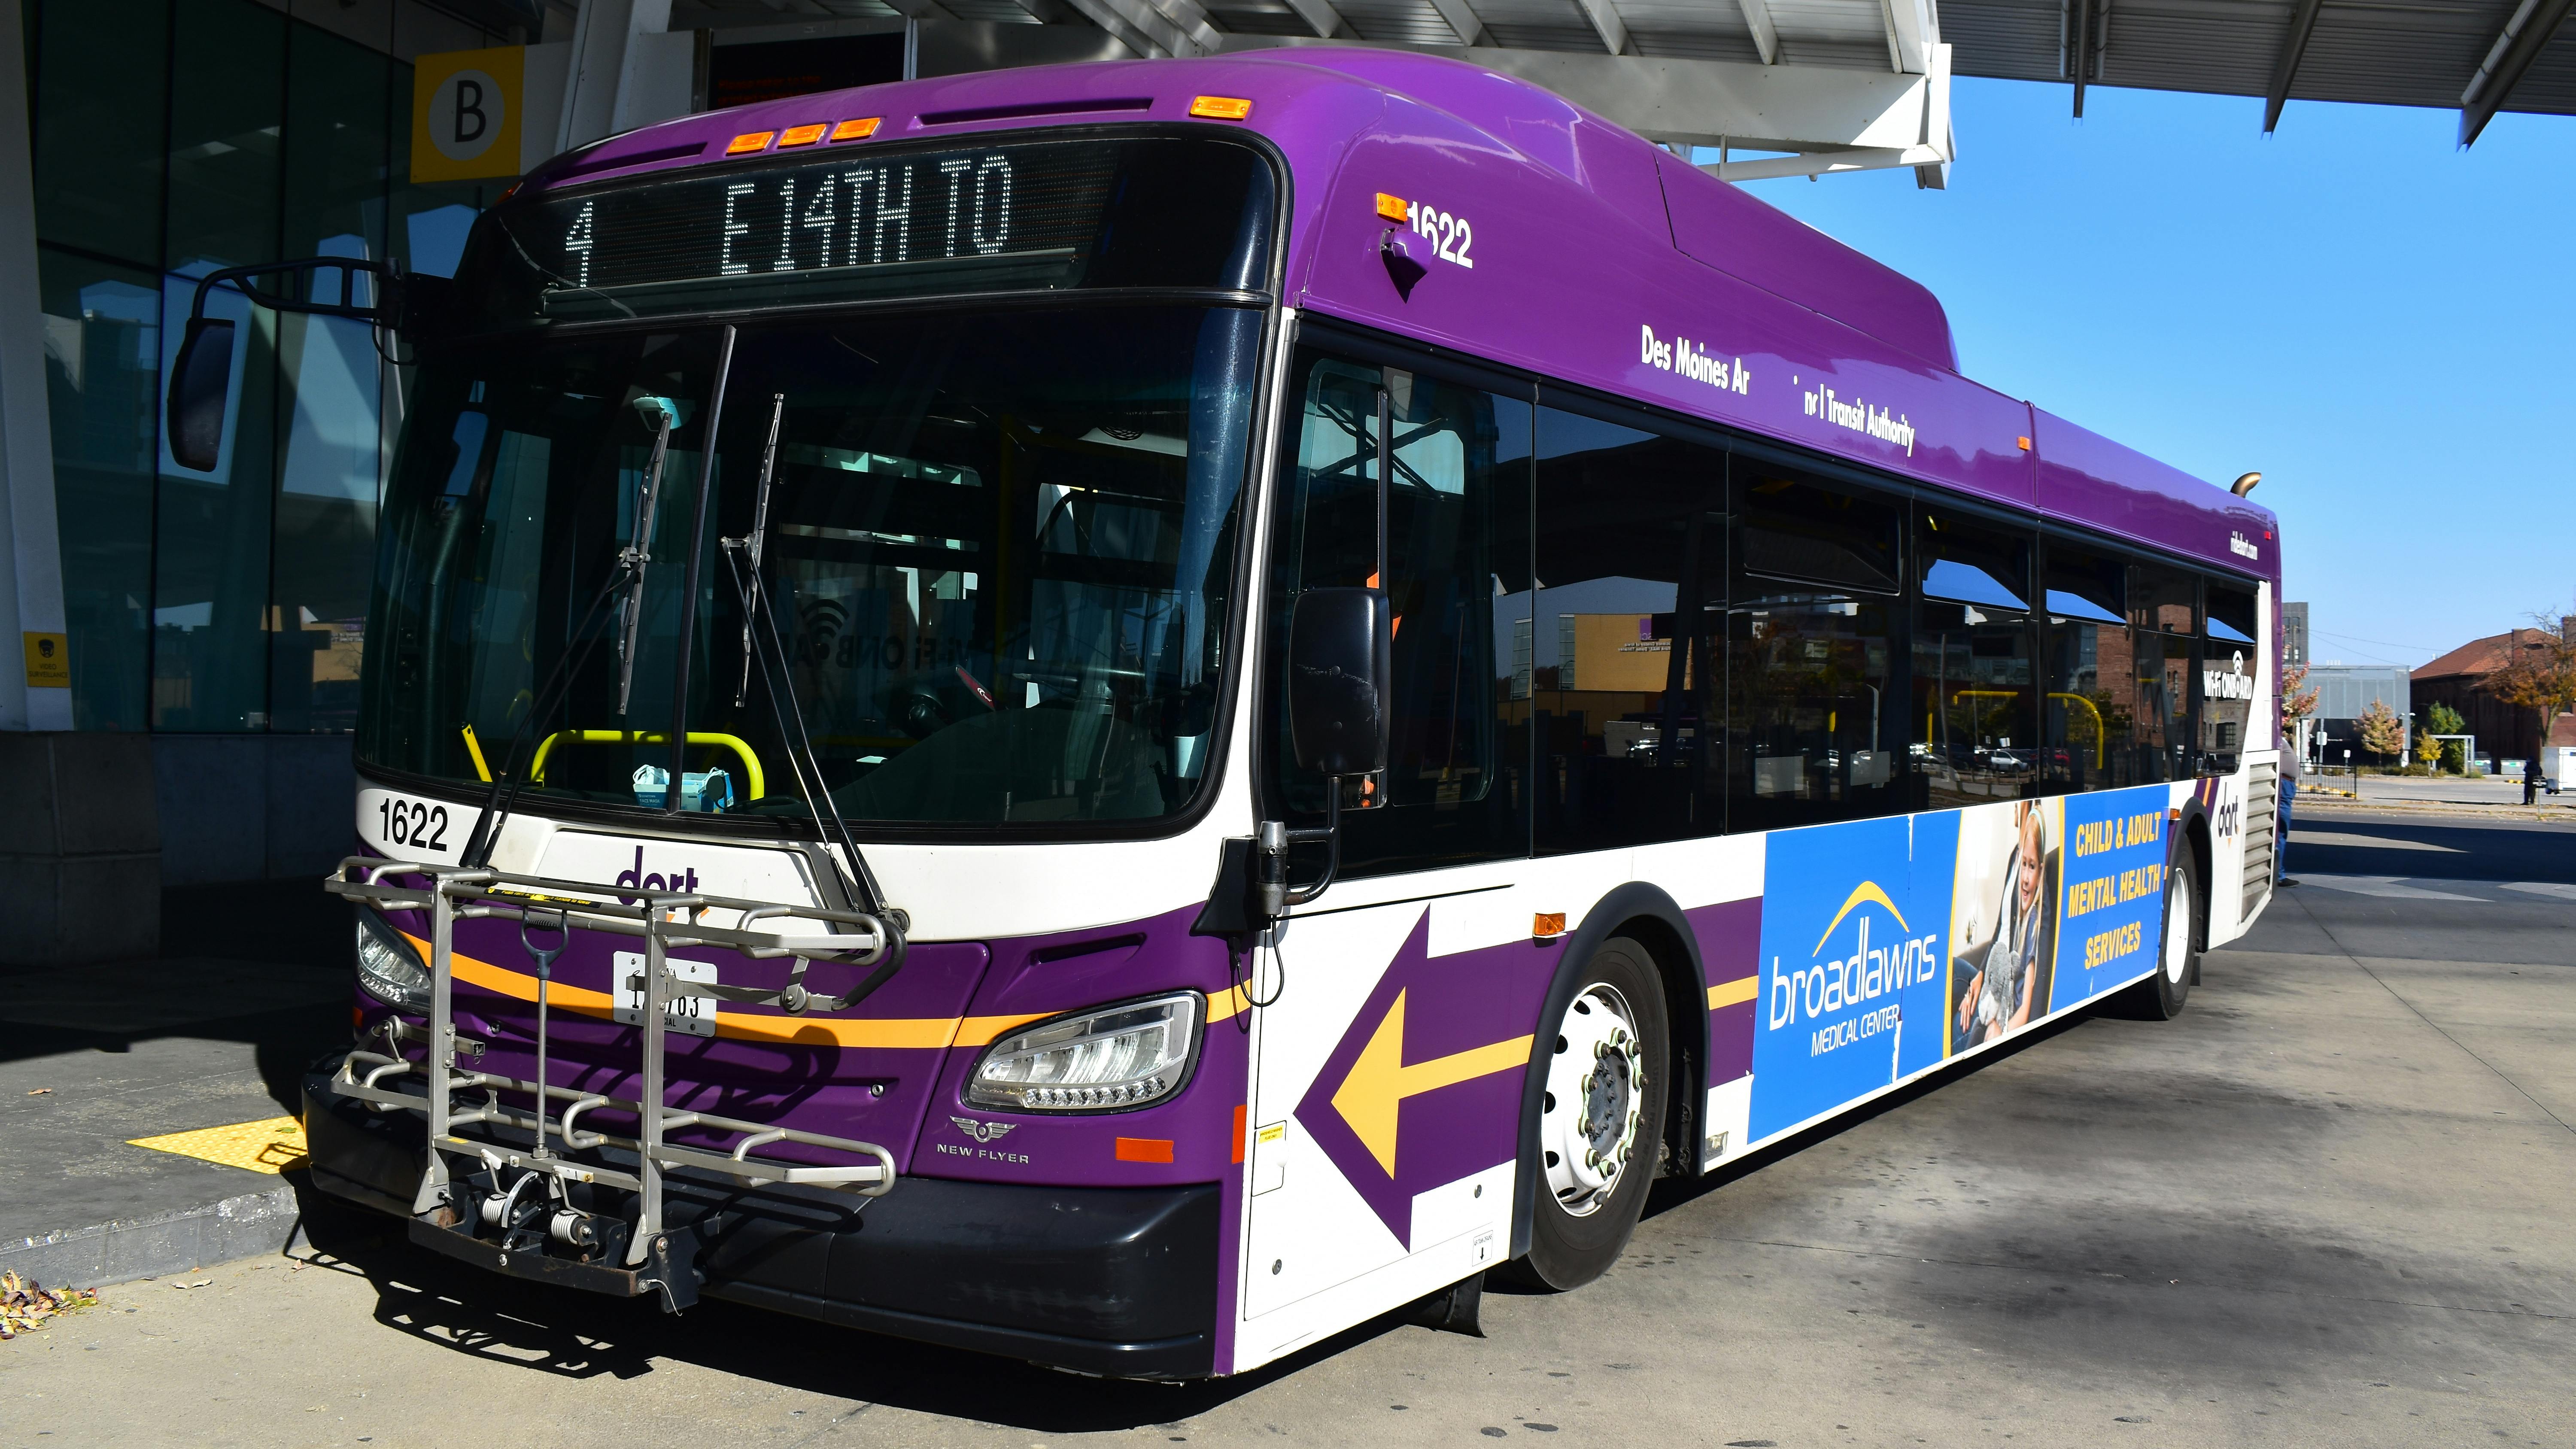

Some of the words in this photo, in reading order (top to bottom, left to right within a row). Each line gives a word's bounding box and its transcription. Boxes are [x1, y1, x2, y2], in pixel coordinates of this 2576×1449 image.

[454, 80, 486, 143] B
[565, 201, 593, 288] 4
[721, 182, 755, 275] E
[774, 165, 912, 271] 14TH
[940, 155, 1012, 257] TO
[1406, 201, 1473, 269] 1622
[1641, 324, 1671, 371] Des
[1675, 336, 1728, 389] Moines
[1827, 389, 1865, 431] Transit
[1866, 404, 1915, 457] Authority
[380, 798, 448, 852] 1622
[2075, 820, 2113, 857] CHILD
[2115, 817, 2123, 849] &
[2126, 812, 2161, 847] ADULT
[2218, 782, 2238, 838] dart
[2068, 875, 2117, 918] MENTAL
[2119, 863, 2161, 903] HEALTH
[2084, 920, 2141, 970] SERVICES
[1769, 916, 1936, 1031] broadlawns
[1811, 1018, 1859, 1057] MEDICAL
[1861, 1004, 1899, 1038] CENTER
[937, 1143, 973, 1156] NEW
[978, 1149, 1029, 1164] FLYER
